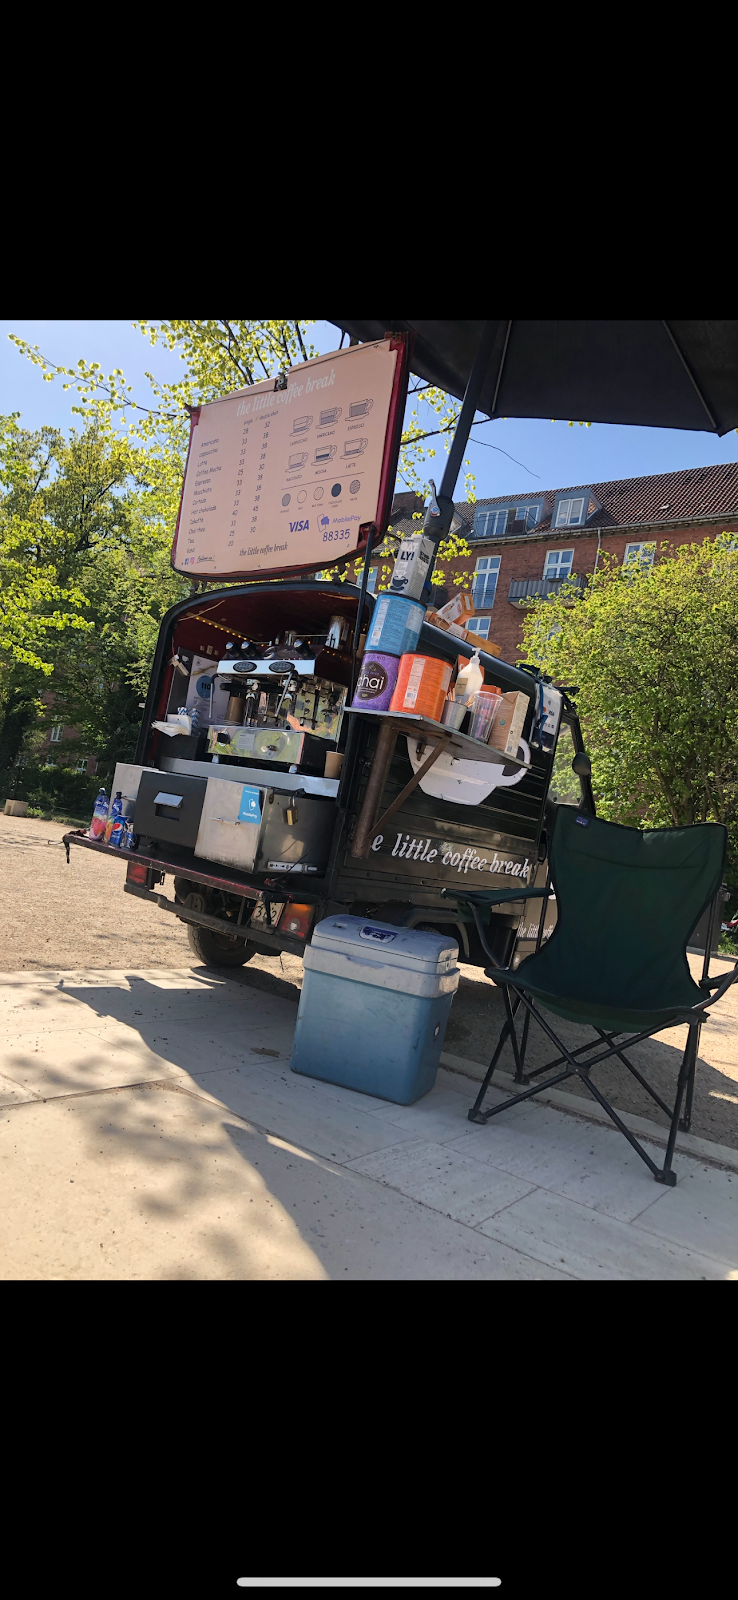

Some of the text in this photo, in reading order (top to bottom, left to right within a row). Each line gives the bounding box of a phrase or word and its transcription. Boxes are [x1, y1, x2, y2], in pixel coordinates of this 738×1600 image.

[236, 369, 336, 416] the little coffee break
[289, 519, 310, 532] VISA
[332, 515, 361, 524] MobilePay
[323, 529, 350, 542] 88335
[247, 546, 259, 556] little
[260, 544, 273, 555] coffee
[274, 542, 288, 552] break
[400, 551, 415, 560] LY!
[357, 674, 384, 690] chai
[391, 833, 438, 864] little
[442, 847, 488, 874] coffee
[490, 853, 530, 878] break
